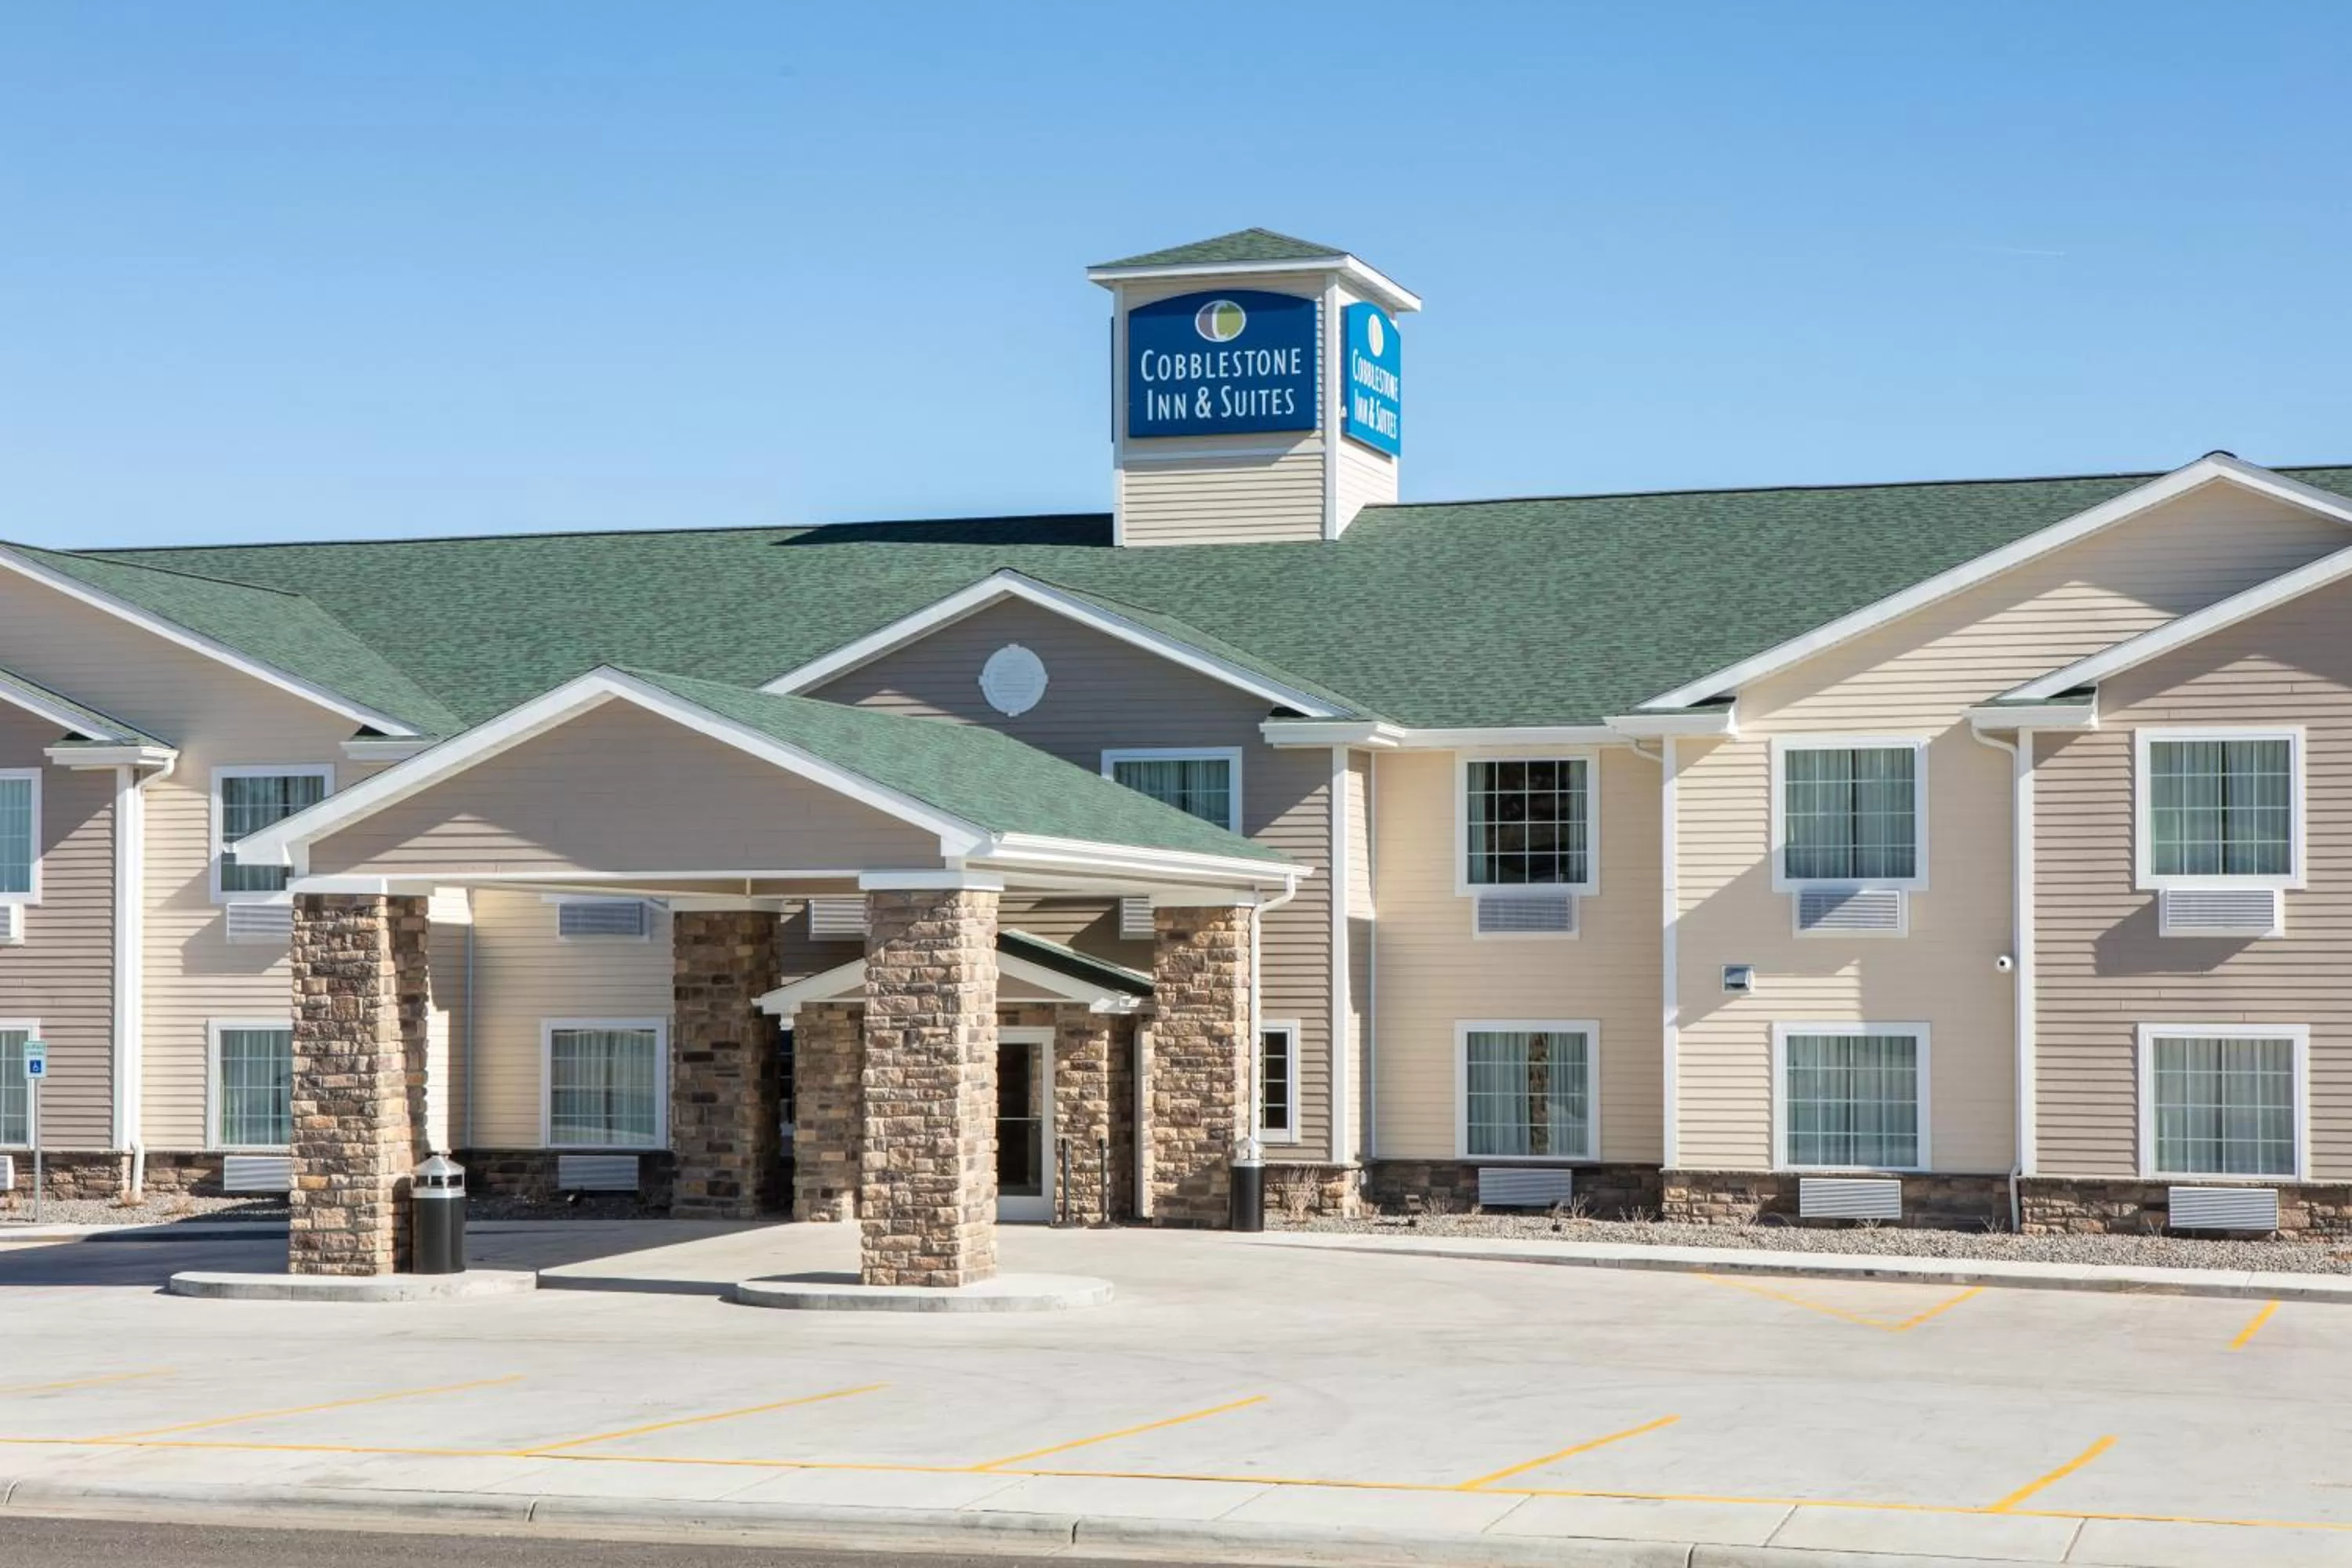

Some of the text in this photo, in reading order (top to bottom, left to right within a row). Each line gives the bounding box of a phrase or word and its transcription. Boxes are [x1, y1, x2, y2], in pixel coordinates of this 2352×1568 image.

[1142, 348, 1301, 382] COBBLESTONE
[1352, 349, 1399, 402] COBBLESTONE
[1147, 385, 1295, 421] INN & SUITES
[1354, 389, 1396, 440] INN & SUITES
